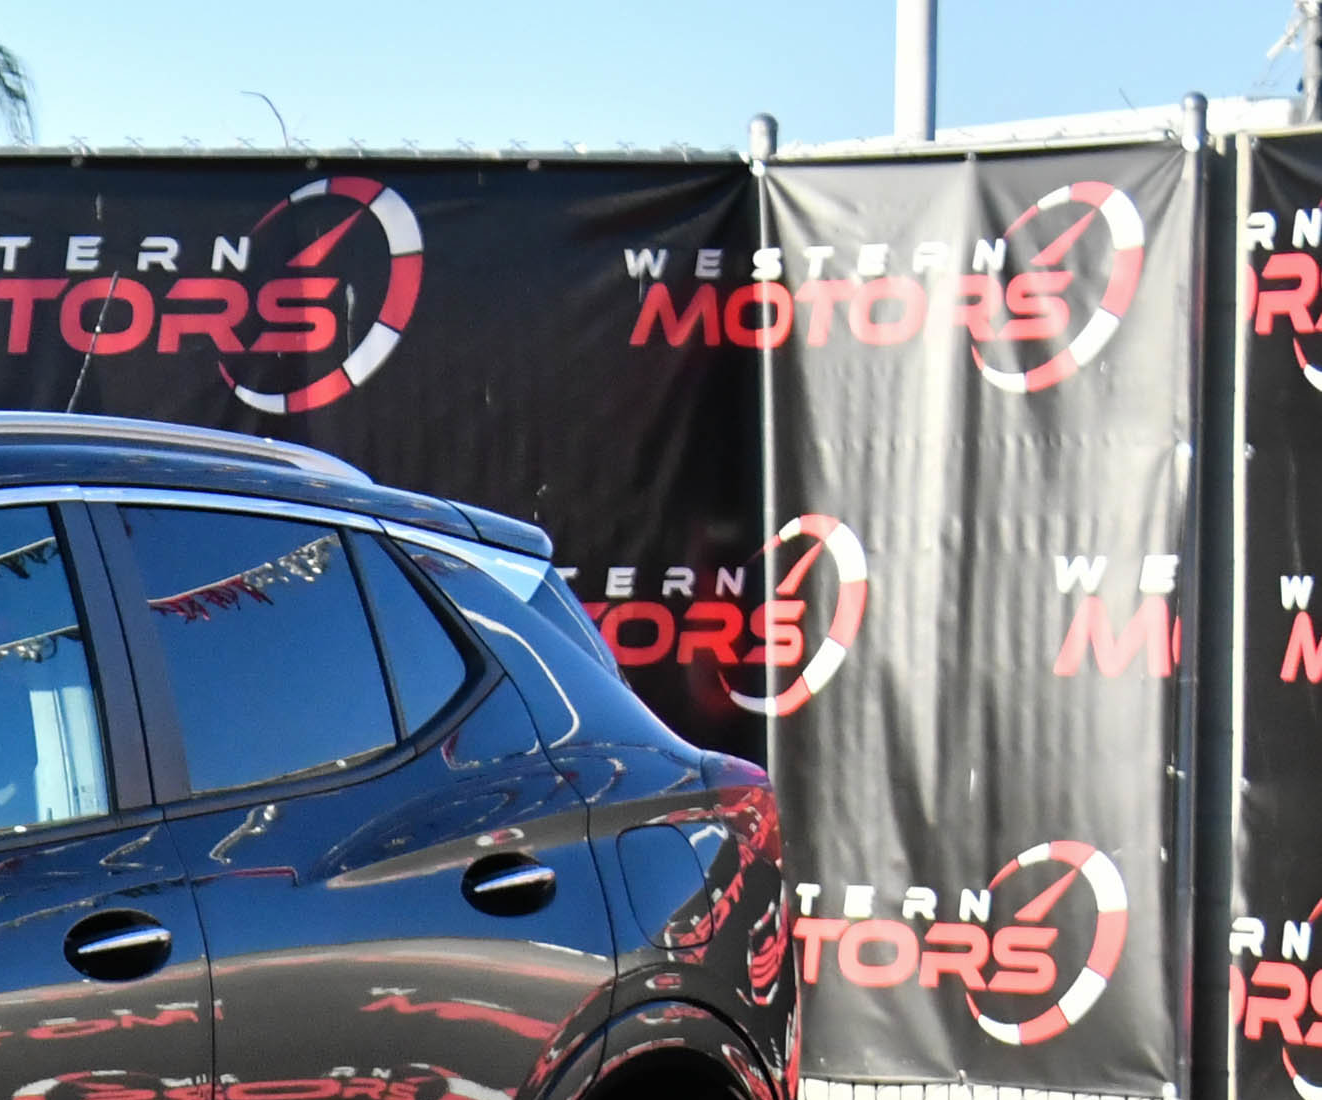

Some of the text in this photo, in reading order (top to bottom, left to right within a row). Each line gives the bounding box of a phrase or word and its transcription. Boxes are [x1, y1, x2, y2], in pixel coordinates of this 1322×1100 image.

[624, 238, 1006, 279] WESTERN
[629, 271, 1074, 348] MOTORS
[582, 600, 806, 667] ORS
